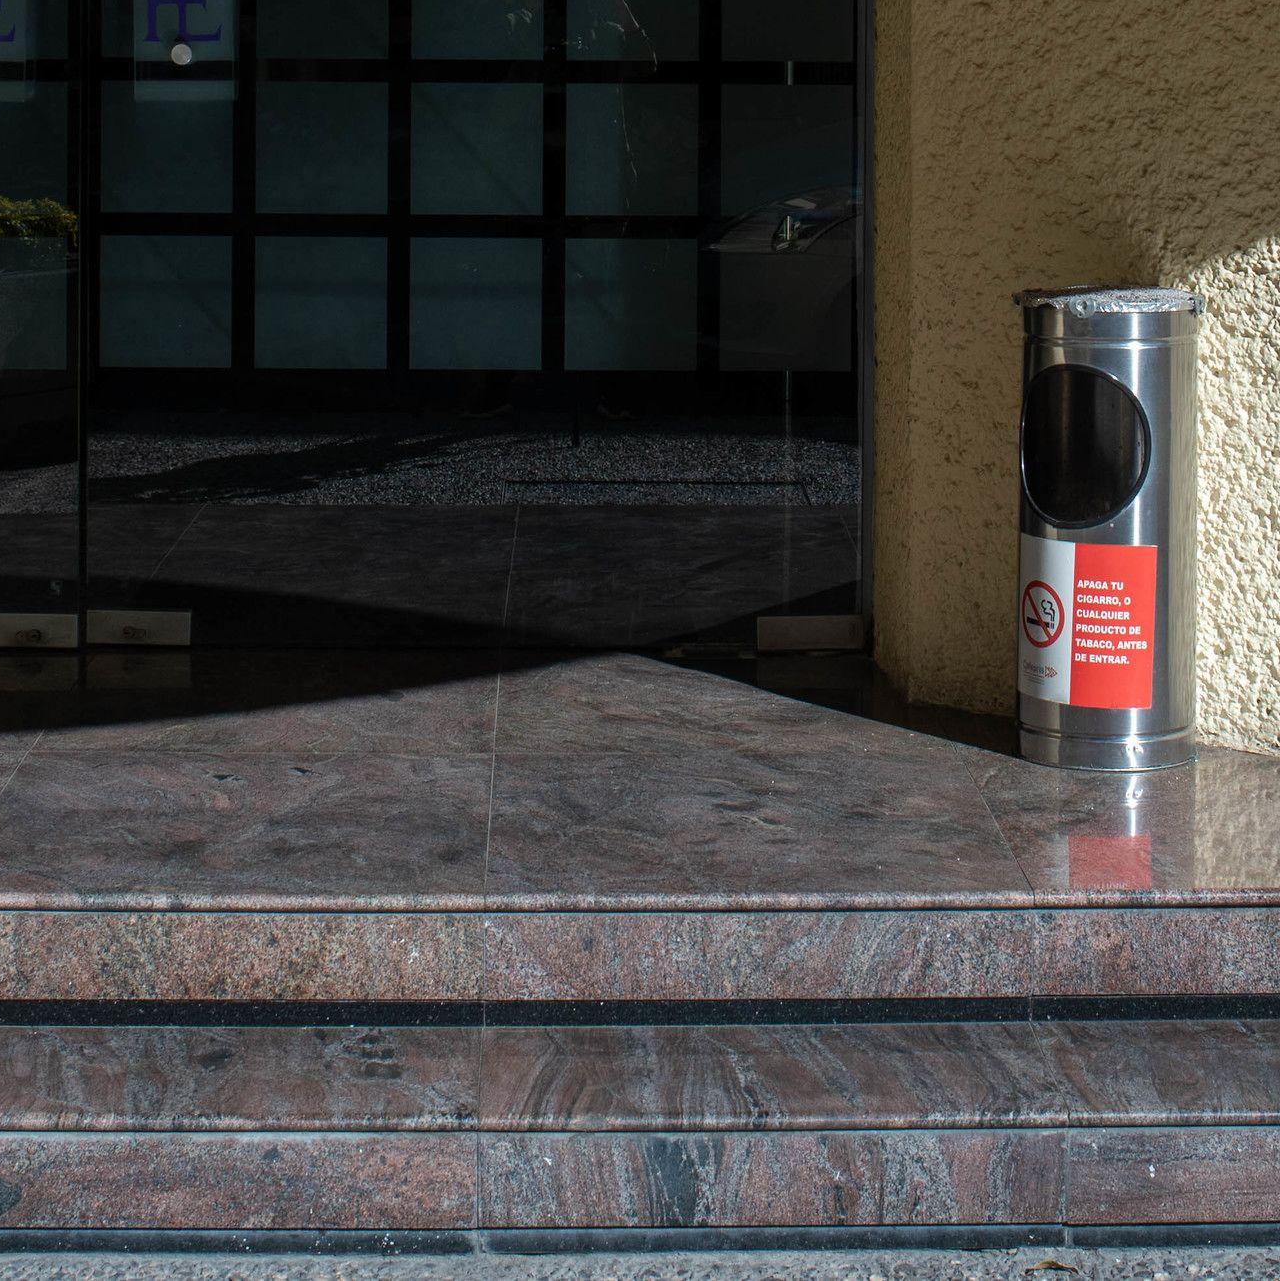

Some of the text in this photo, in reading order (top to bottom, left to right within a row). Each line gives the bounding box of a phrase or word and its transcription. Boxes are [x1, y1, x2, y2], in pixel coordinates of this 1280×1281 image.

[1077, 580, 1124, 591] APAGA TU
[1077, 594, 1131, 606] CIGARRO, O
[1076, 609, 1130, 620] CUALQUIER
[1076, 624, 1141, 635] PRODUCTO DE
[1075, 638, 1148, 650] TABACO, ANTES
[1074, 653, 1130, 664] DE ENTRAR.
